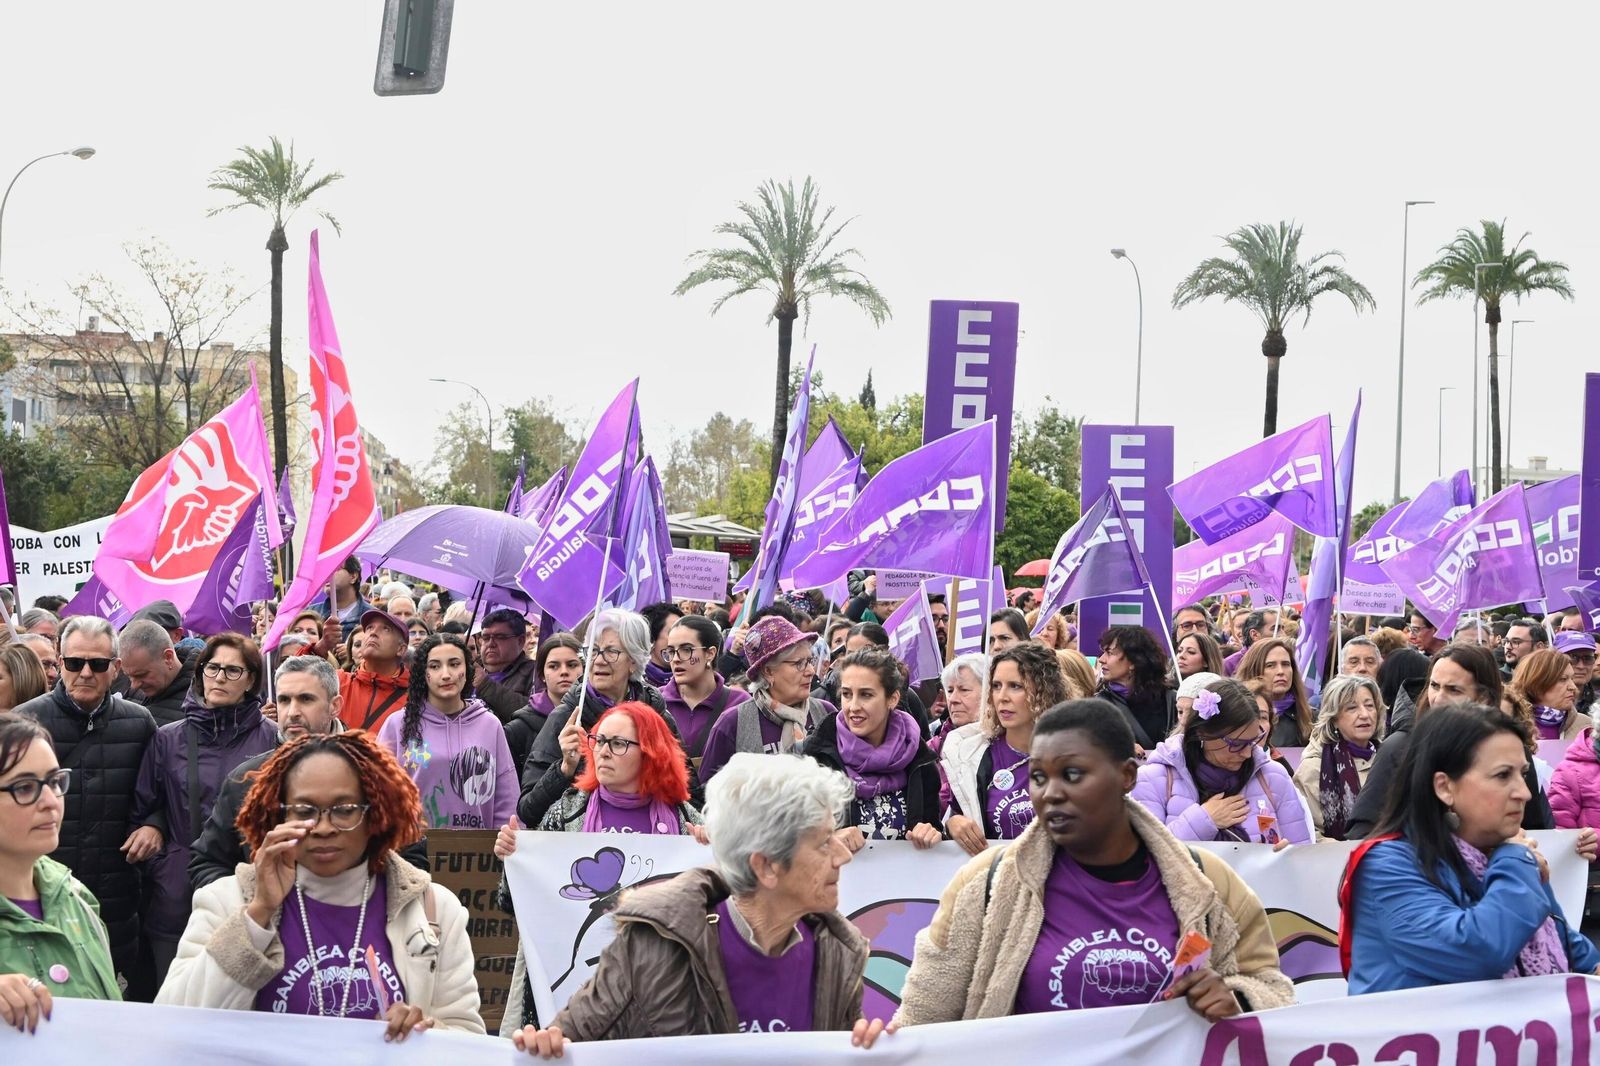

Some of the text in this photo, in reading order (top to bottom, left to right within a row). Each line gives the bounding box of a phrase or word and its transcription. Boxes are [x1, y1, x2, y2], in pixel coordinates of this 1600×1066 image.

[952, 309, 992, 429] CCO
[53, 534, 81, 549] CON
[1048, 928, 1122, 1009] ASAMBLEA
